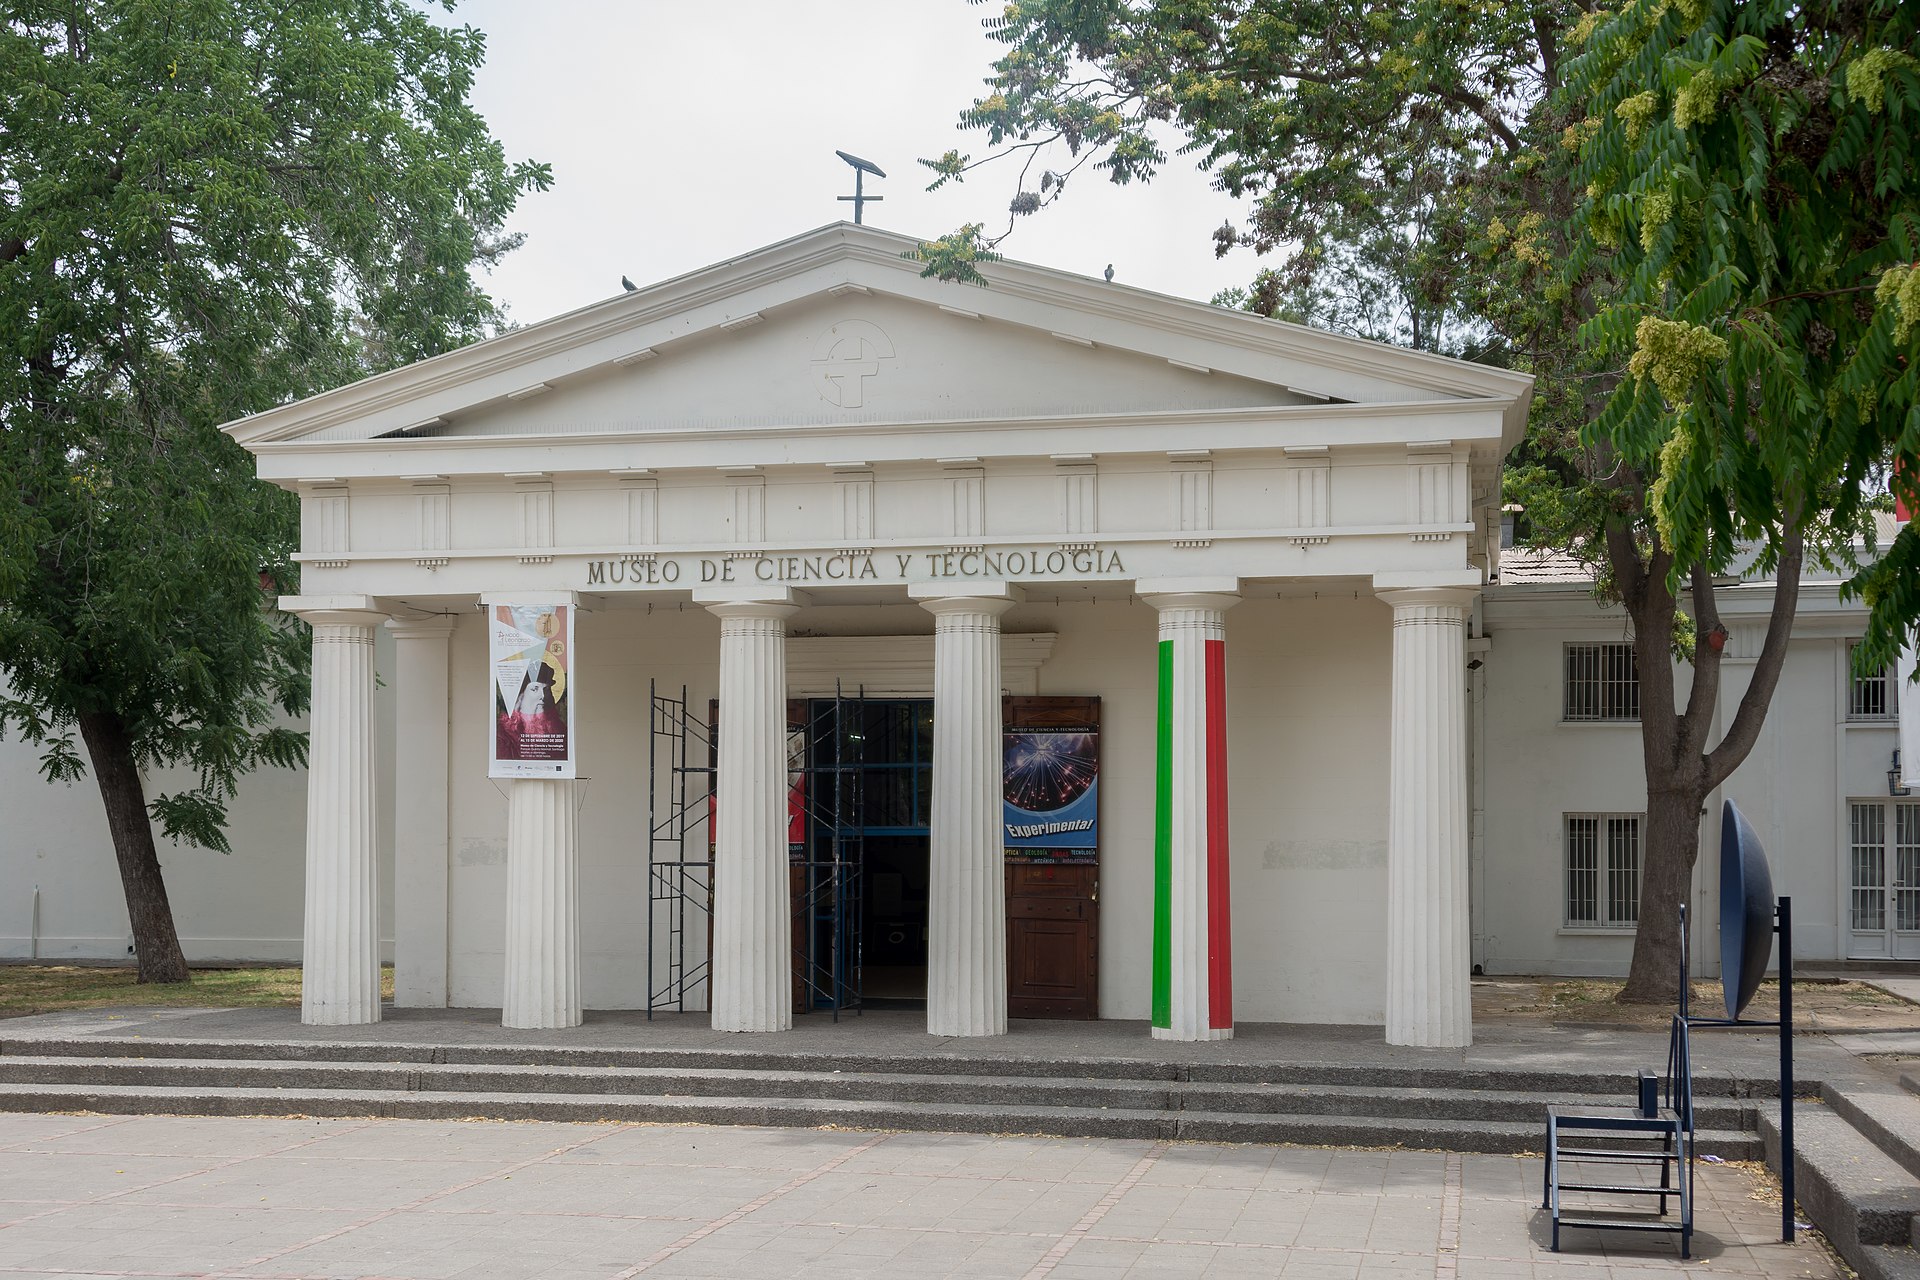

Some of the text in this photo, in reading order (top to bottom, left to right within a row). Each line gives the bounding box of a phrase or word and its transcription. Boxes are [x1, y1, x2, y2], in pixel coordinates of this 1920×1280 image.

[587, 550, 1125, 584] MUSEO DE CIENCIA Y TECNOLOGIA
[1005, 819, 1094, 838] Experimenta!
